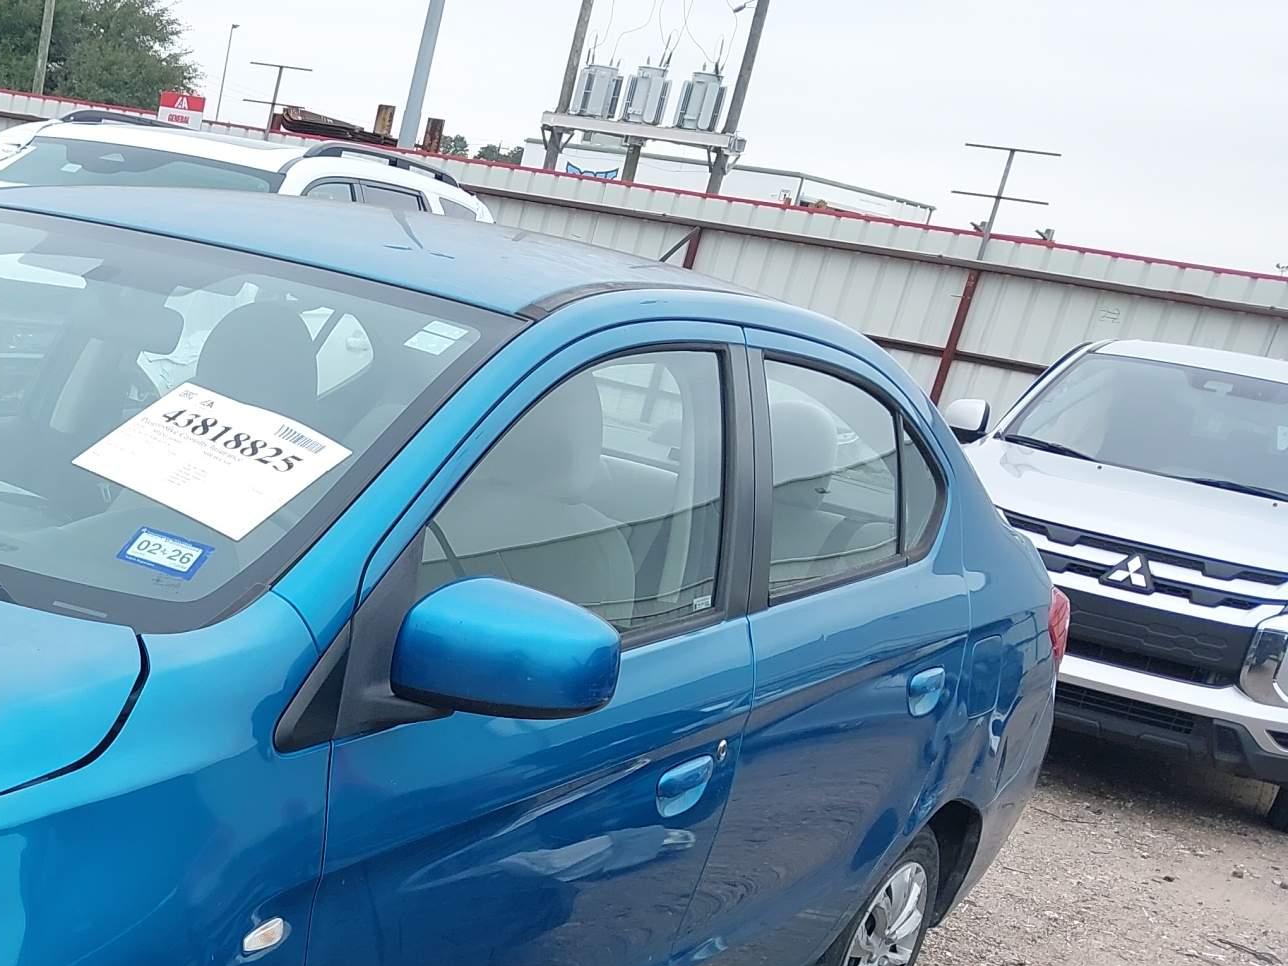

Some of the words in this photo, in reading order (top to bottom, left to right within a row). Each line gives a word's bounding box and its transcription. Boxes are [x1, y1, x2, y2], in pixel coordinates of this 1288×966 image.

[167, 113, 190, 124] GENERAL
[162, 408, 304, 473] 43818825
[137, 539, 162, 555] 02
[167, 549, 194, 564] 26
